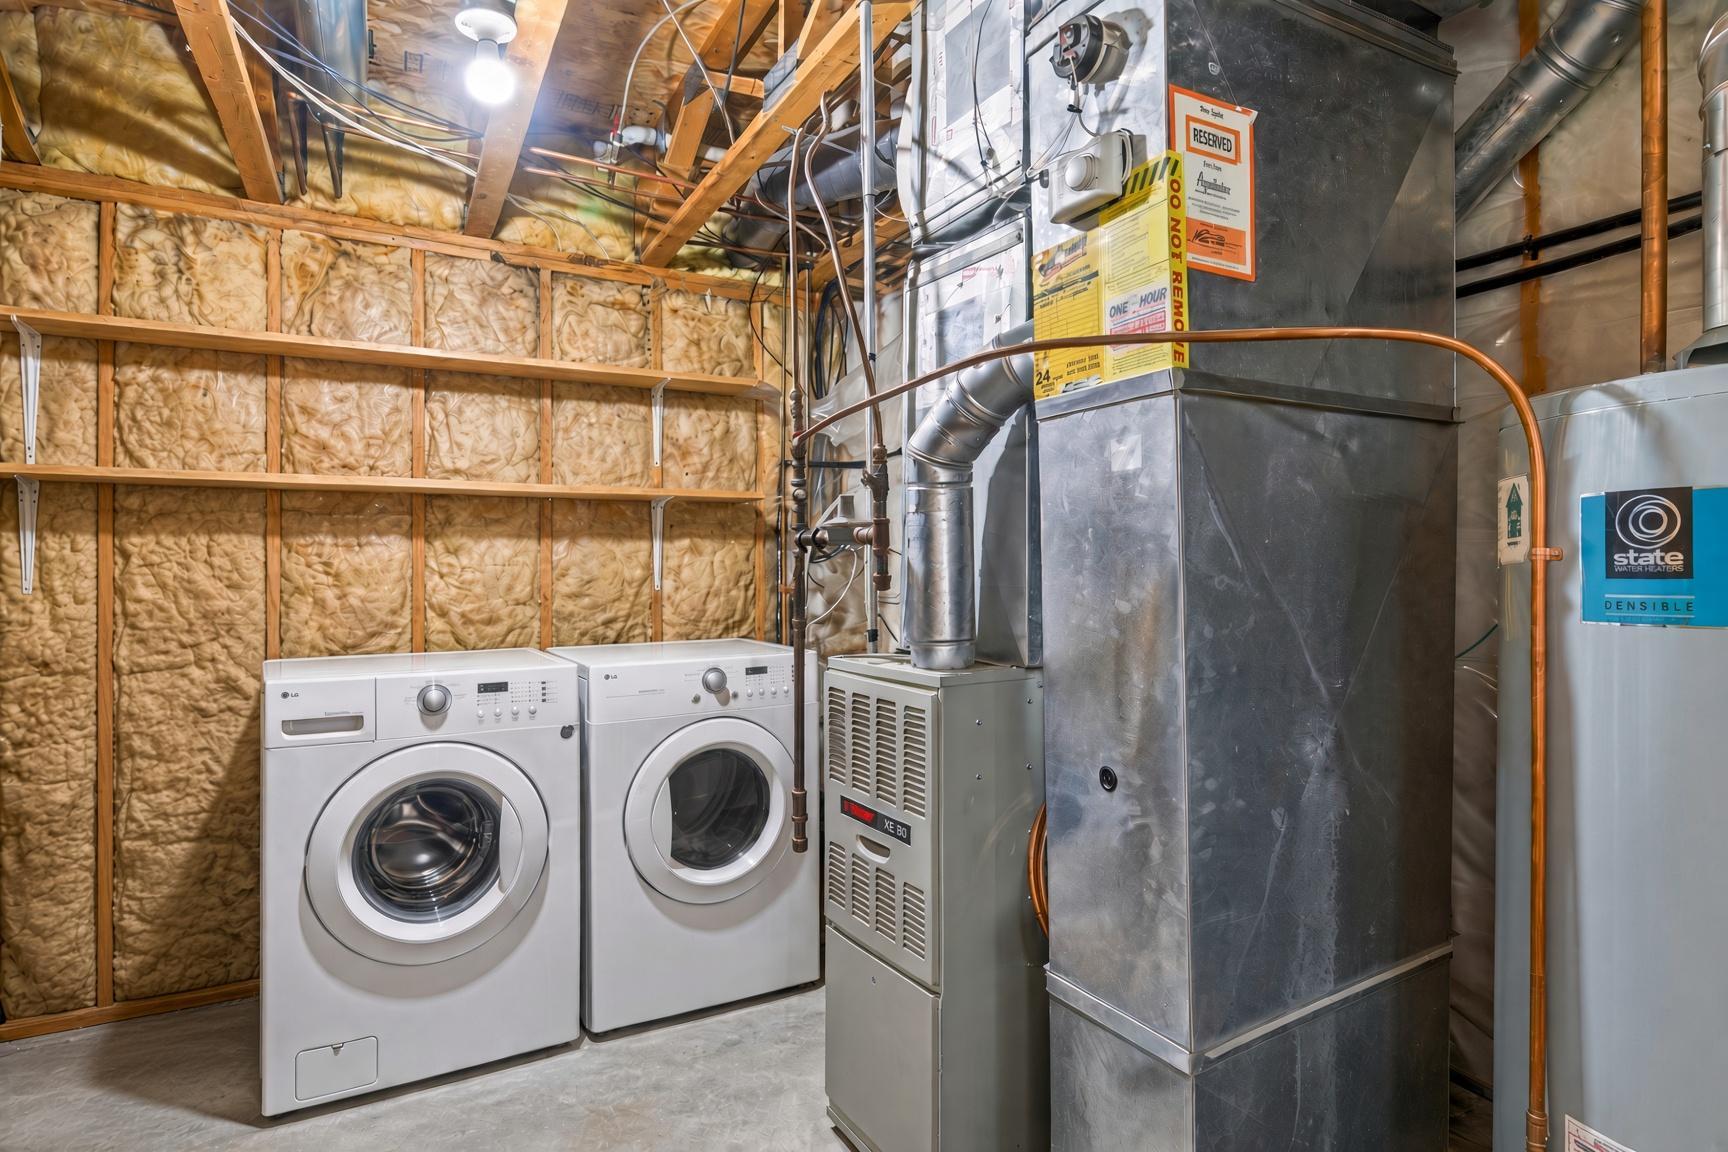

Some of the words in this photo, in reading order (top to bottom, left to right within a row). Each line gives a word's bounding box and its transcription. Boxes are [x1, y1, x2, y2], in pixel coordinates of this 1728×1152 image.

[1193, 127, 1233, 153] RESERVED
[1170, 216, 1182, 265] NOT
[1109, 301, 1128, 319] ONE
[1139, 287, 1167, 308] HOUR
[1035, 369, 1051, 386] 24
[1613, 549, 1684, 565] state
[1614, 565, 1643, 573] WATER
[1645, 565, 1684, 573] HEATERS
[883, 818, 895, 834] XE
